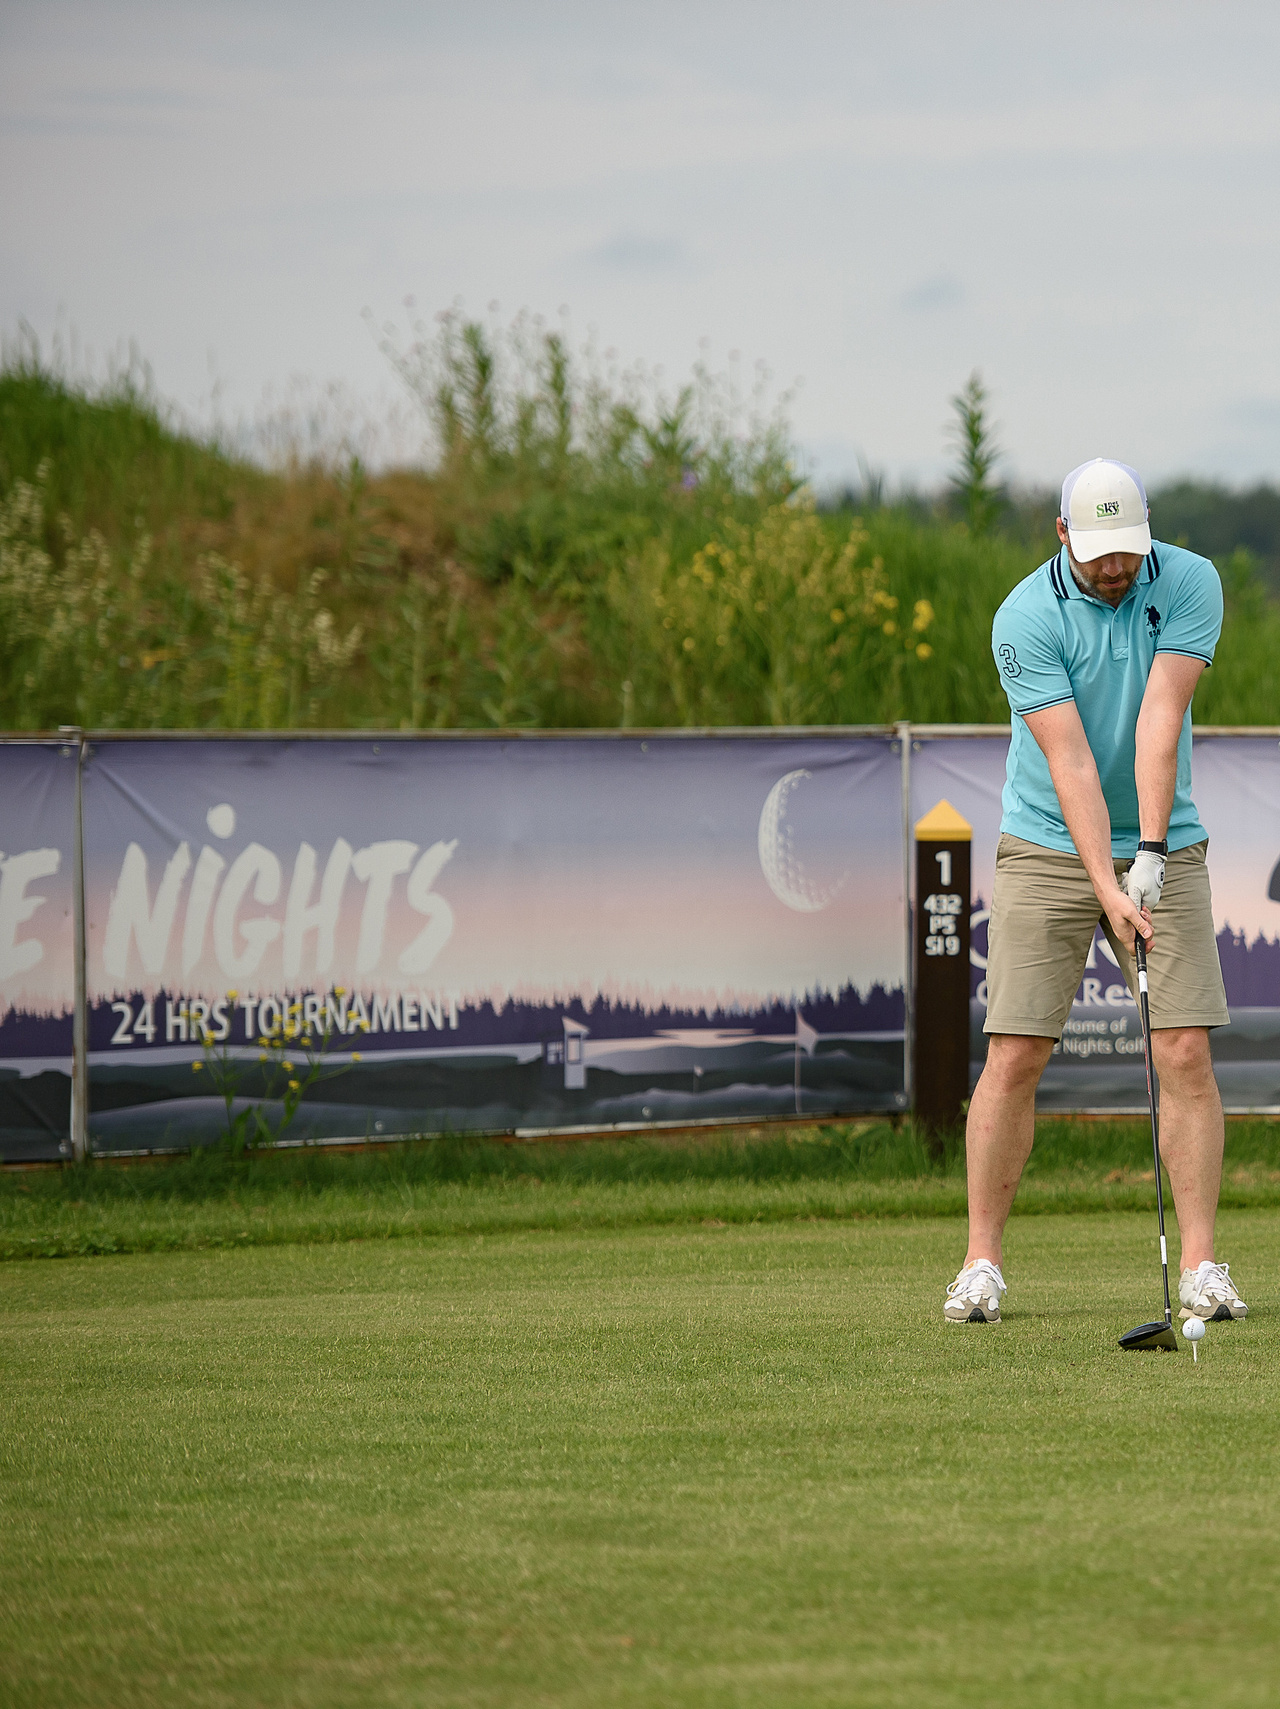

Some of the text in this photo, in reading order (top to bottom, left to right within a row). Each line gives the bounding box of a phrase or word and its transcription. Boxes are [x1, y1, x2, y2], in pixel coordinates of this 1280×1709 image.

[999, 643, 1022, 678] 3
[934, 850, 952, 887] 1
[923, 893, 962, 915] 432
[111, 989, 460, 1046] 24 HRS TOURNAMENT
[1109, 1016, 1129, 1035] of
[1062, 1036, 1114, 1059] Nights
